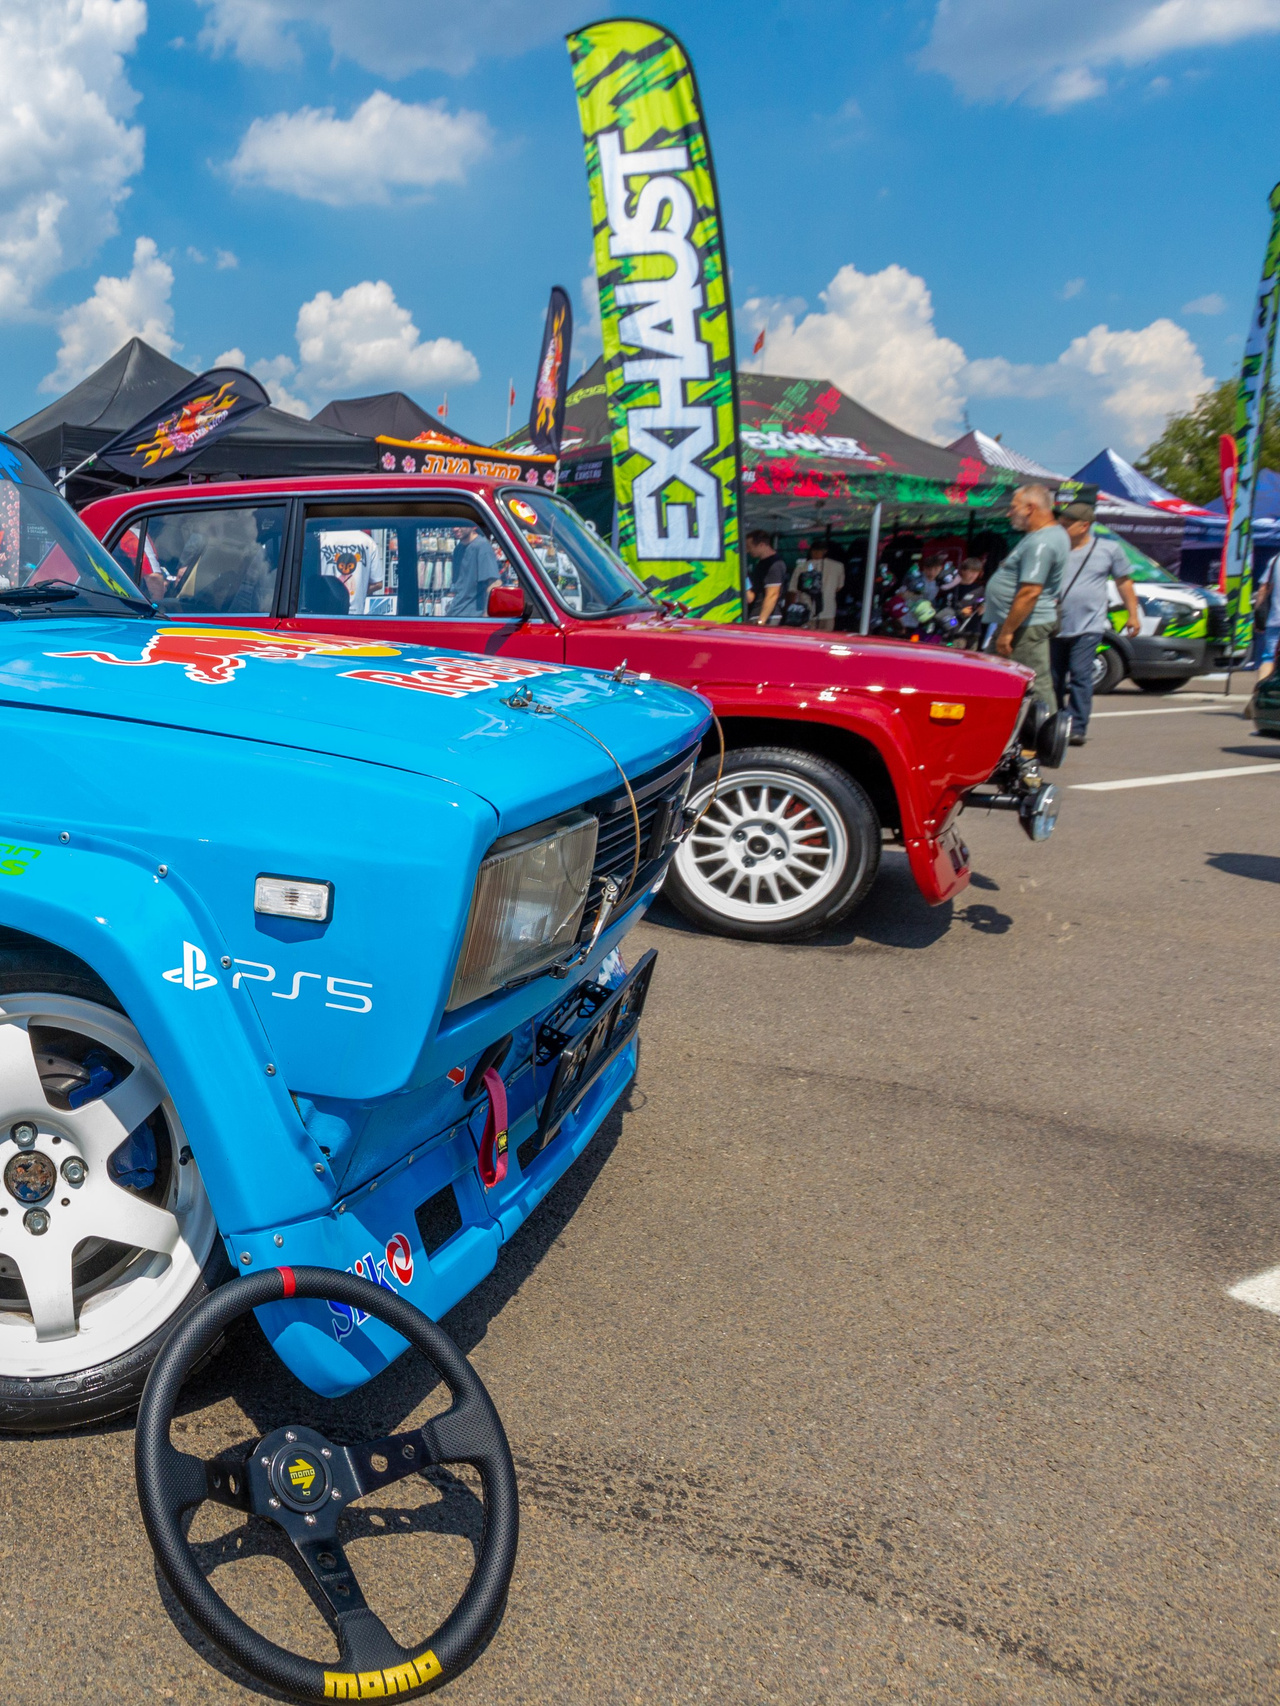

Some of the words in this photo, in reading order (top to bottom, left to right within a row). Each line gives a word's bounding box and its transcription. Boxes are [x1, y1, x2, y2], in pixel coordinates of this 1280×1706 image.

[598, 132, 723, 560] EXHAUST
[230, 957, 374, 1014] PS5
[290, 1468, 316, 1479] momo
[324, 1649, 443, 1699] momo
